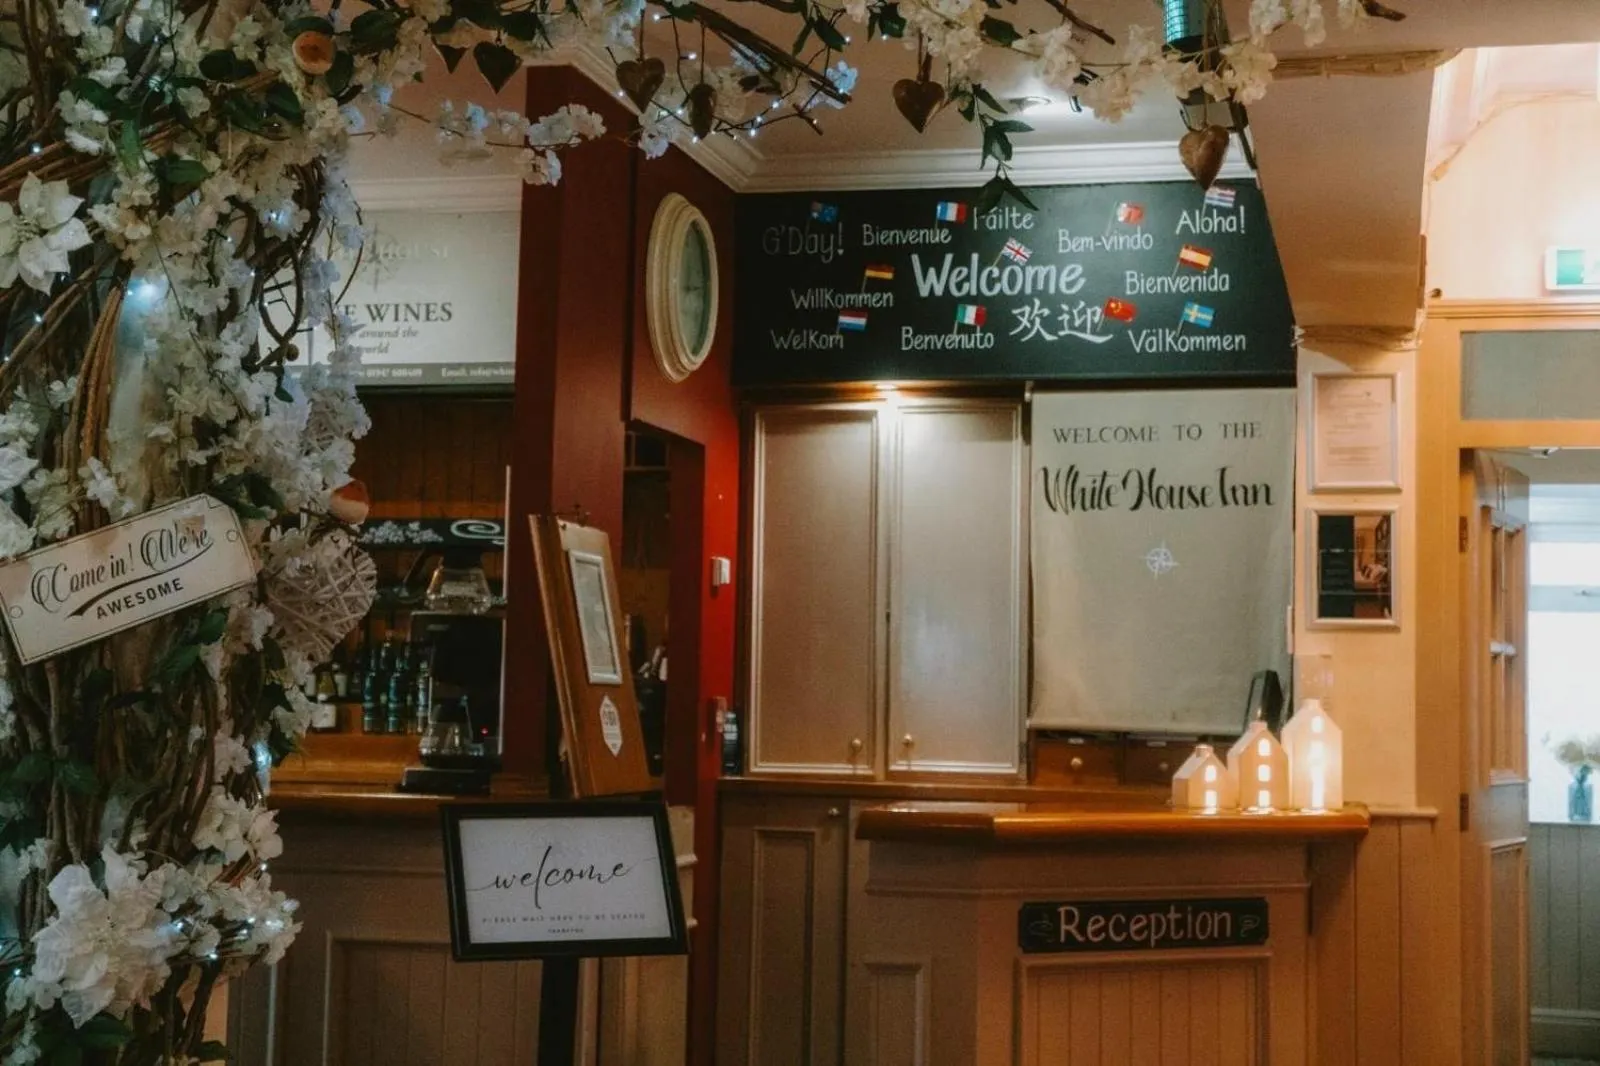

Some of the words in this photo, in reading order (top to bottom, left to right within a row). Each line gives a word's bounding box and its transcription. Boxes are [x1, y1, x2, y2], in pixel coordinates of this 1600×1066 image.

[862, 223, 952, 247] Bienvenue
[1175, 205, 1246, 235] Aloha!
[763, 221, 845, 264] G'Day!
[1058, 226, 1154, 254] Bem-vindo
[912, 253, 1086, 298] Welcome
[1125, 268, 1230, 295] Bienvenida
[366, 302, 453, 322] WINES
[1009, 298, 1114, 344] 欢迎
[359, 326, 399, 338] around
[402, 326, 419, 338] the
[901, 325, 994, 351] Benvenuto
[1053, 425, 1160, 444] WELCOME
[1173, 423, 1203, 441] TO
[1219, 422, 1263, 439] THE
[1041, 464, 1119, 515] White
[1122, 466, 1214, 511] House
[1216, 465, 1275, 508] Inn
[31, 562, 106, 614] Come
[110, 543, 135, 580] in!
[141, 519, 212, 573] We're
[96, 577, 185, 620] AWESOME
[468, 845, 640, 910] welcome
[1057, 904, 1232, 948] Reception
